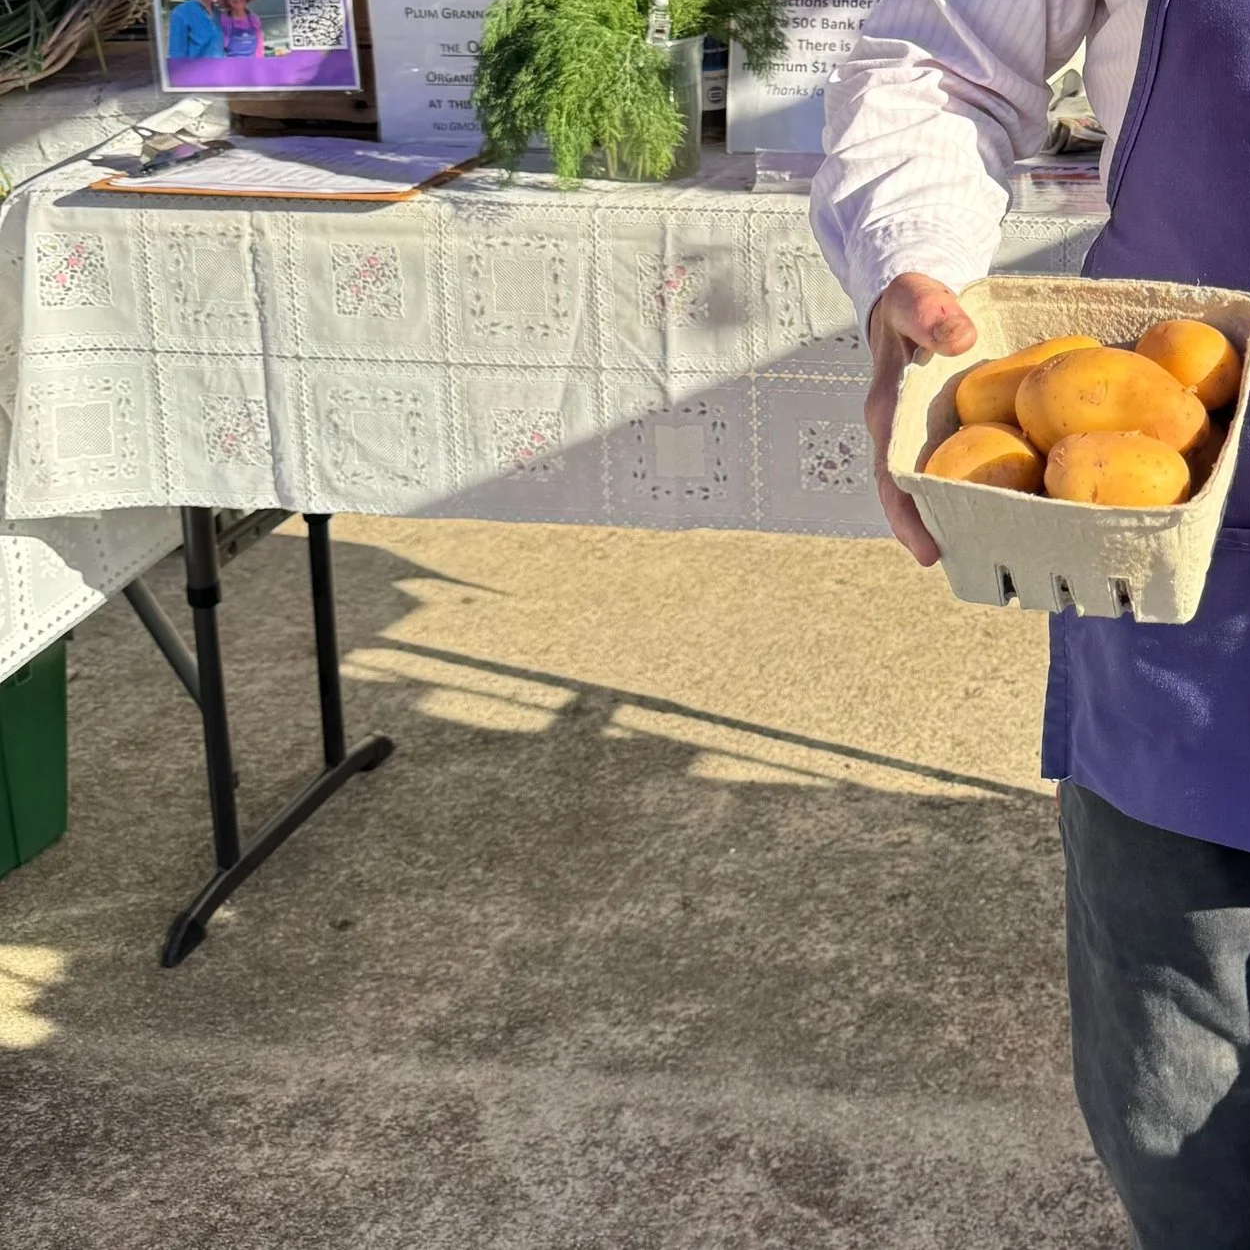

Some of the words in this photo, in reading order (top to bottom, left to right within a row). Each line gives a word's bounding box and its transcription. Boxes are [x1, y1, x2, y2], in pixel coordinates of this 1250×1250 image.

[821, 17, 855, 31] Bank
[797, 38, 838, 52] There
[840, 40, 852, 52] is
[766, 83, 809, 97] Thanks
